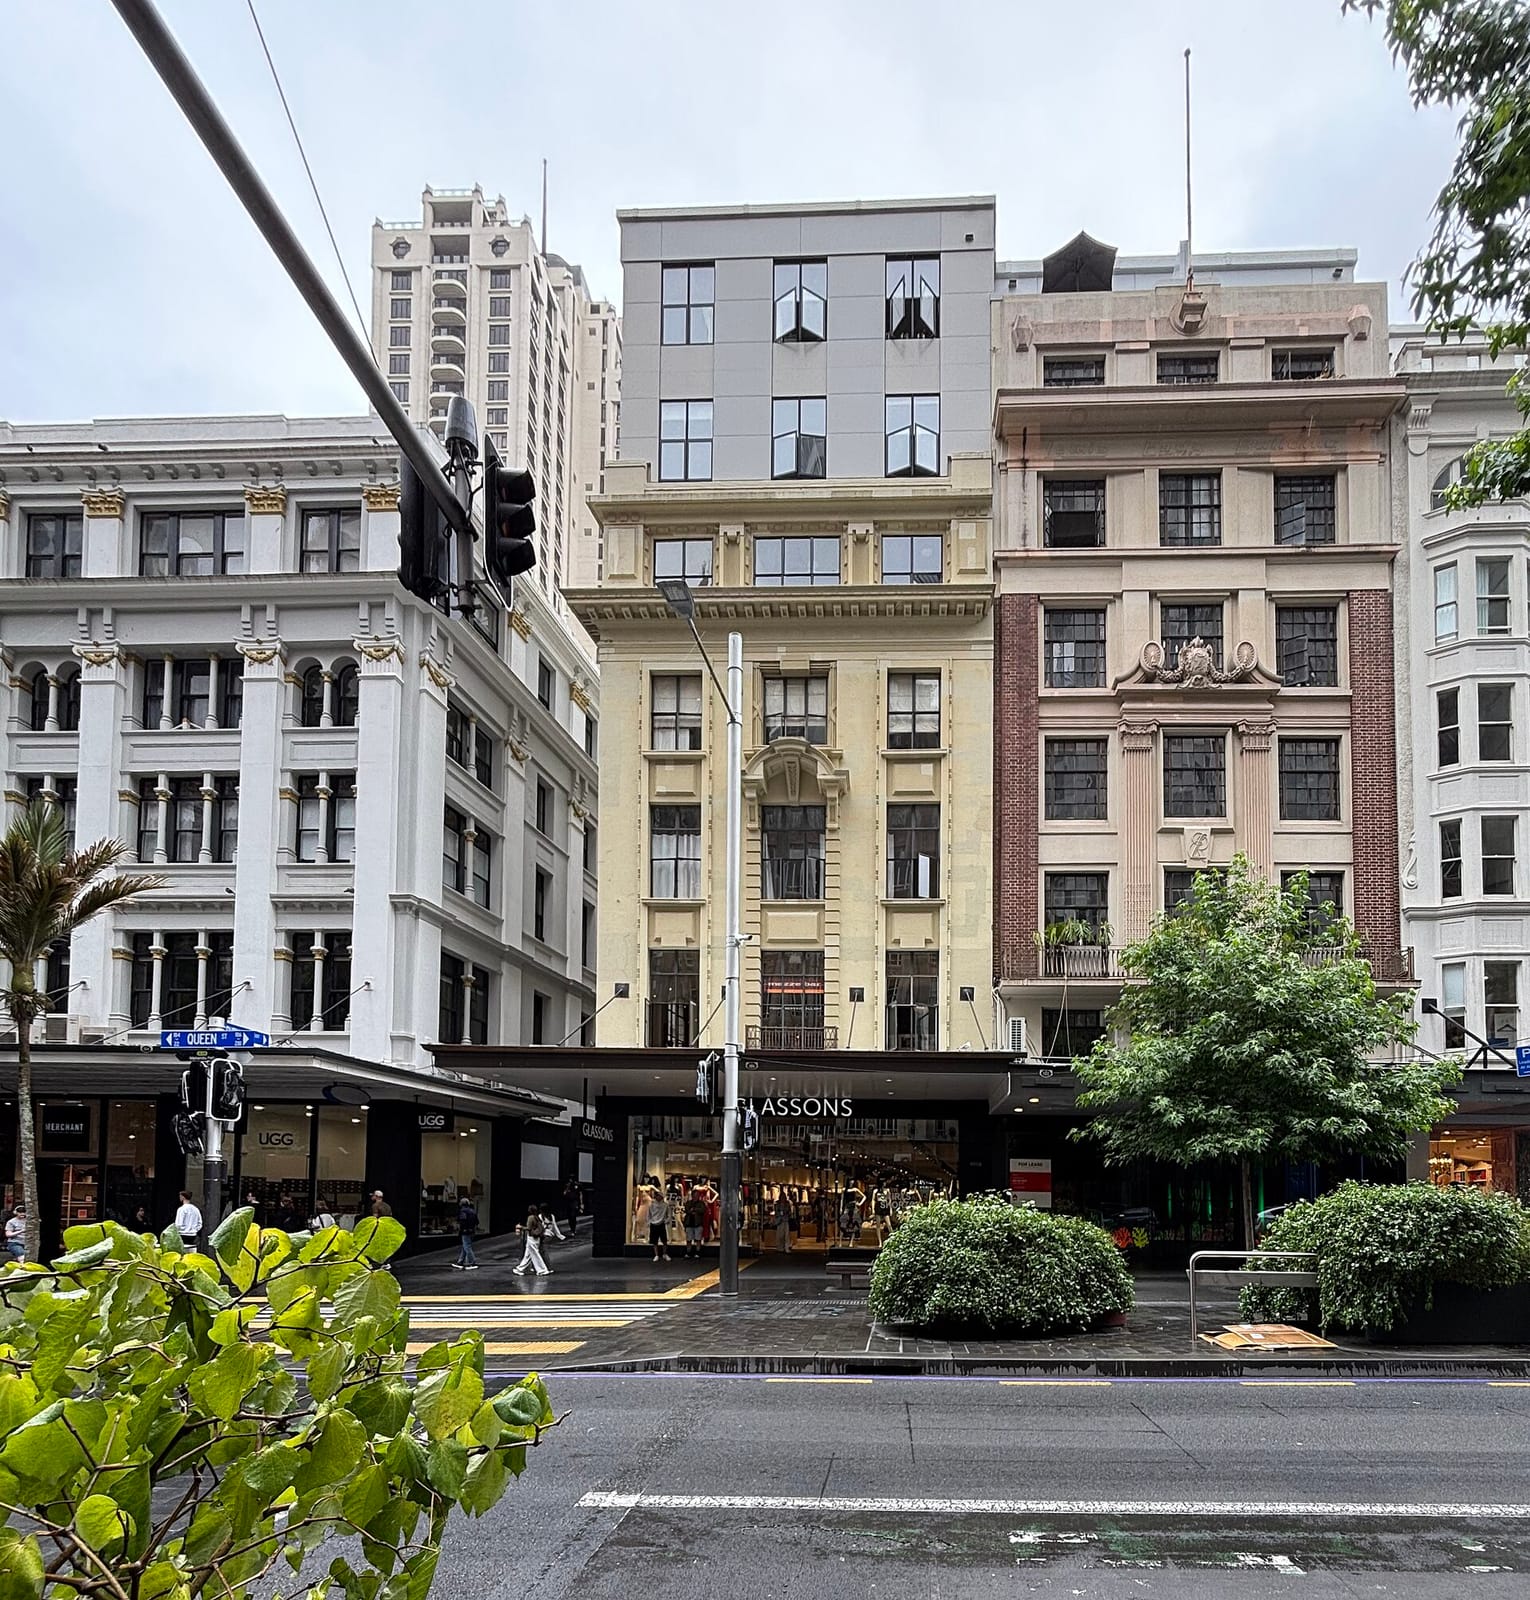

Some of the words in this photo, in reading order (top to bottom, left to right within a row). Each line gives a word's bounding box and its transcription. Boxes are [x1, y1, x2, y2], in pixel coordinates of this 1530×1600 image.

[187, 1033, 217, 1045] QUEEN
[738, 1098, 852, 1117] ASSONS
[45, 1122, 83, 1131] MERCHANT
[418, 1115, 445, 1126] UGG
[582, 1122, 614, 1142] GLASSONS
[259, 1132, 294, 1146] UGG
